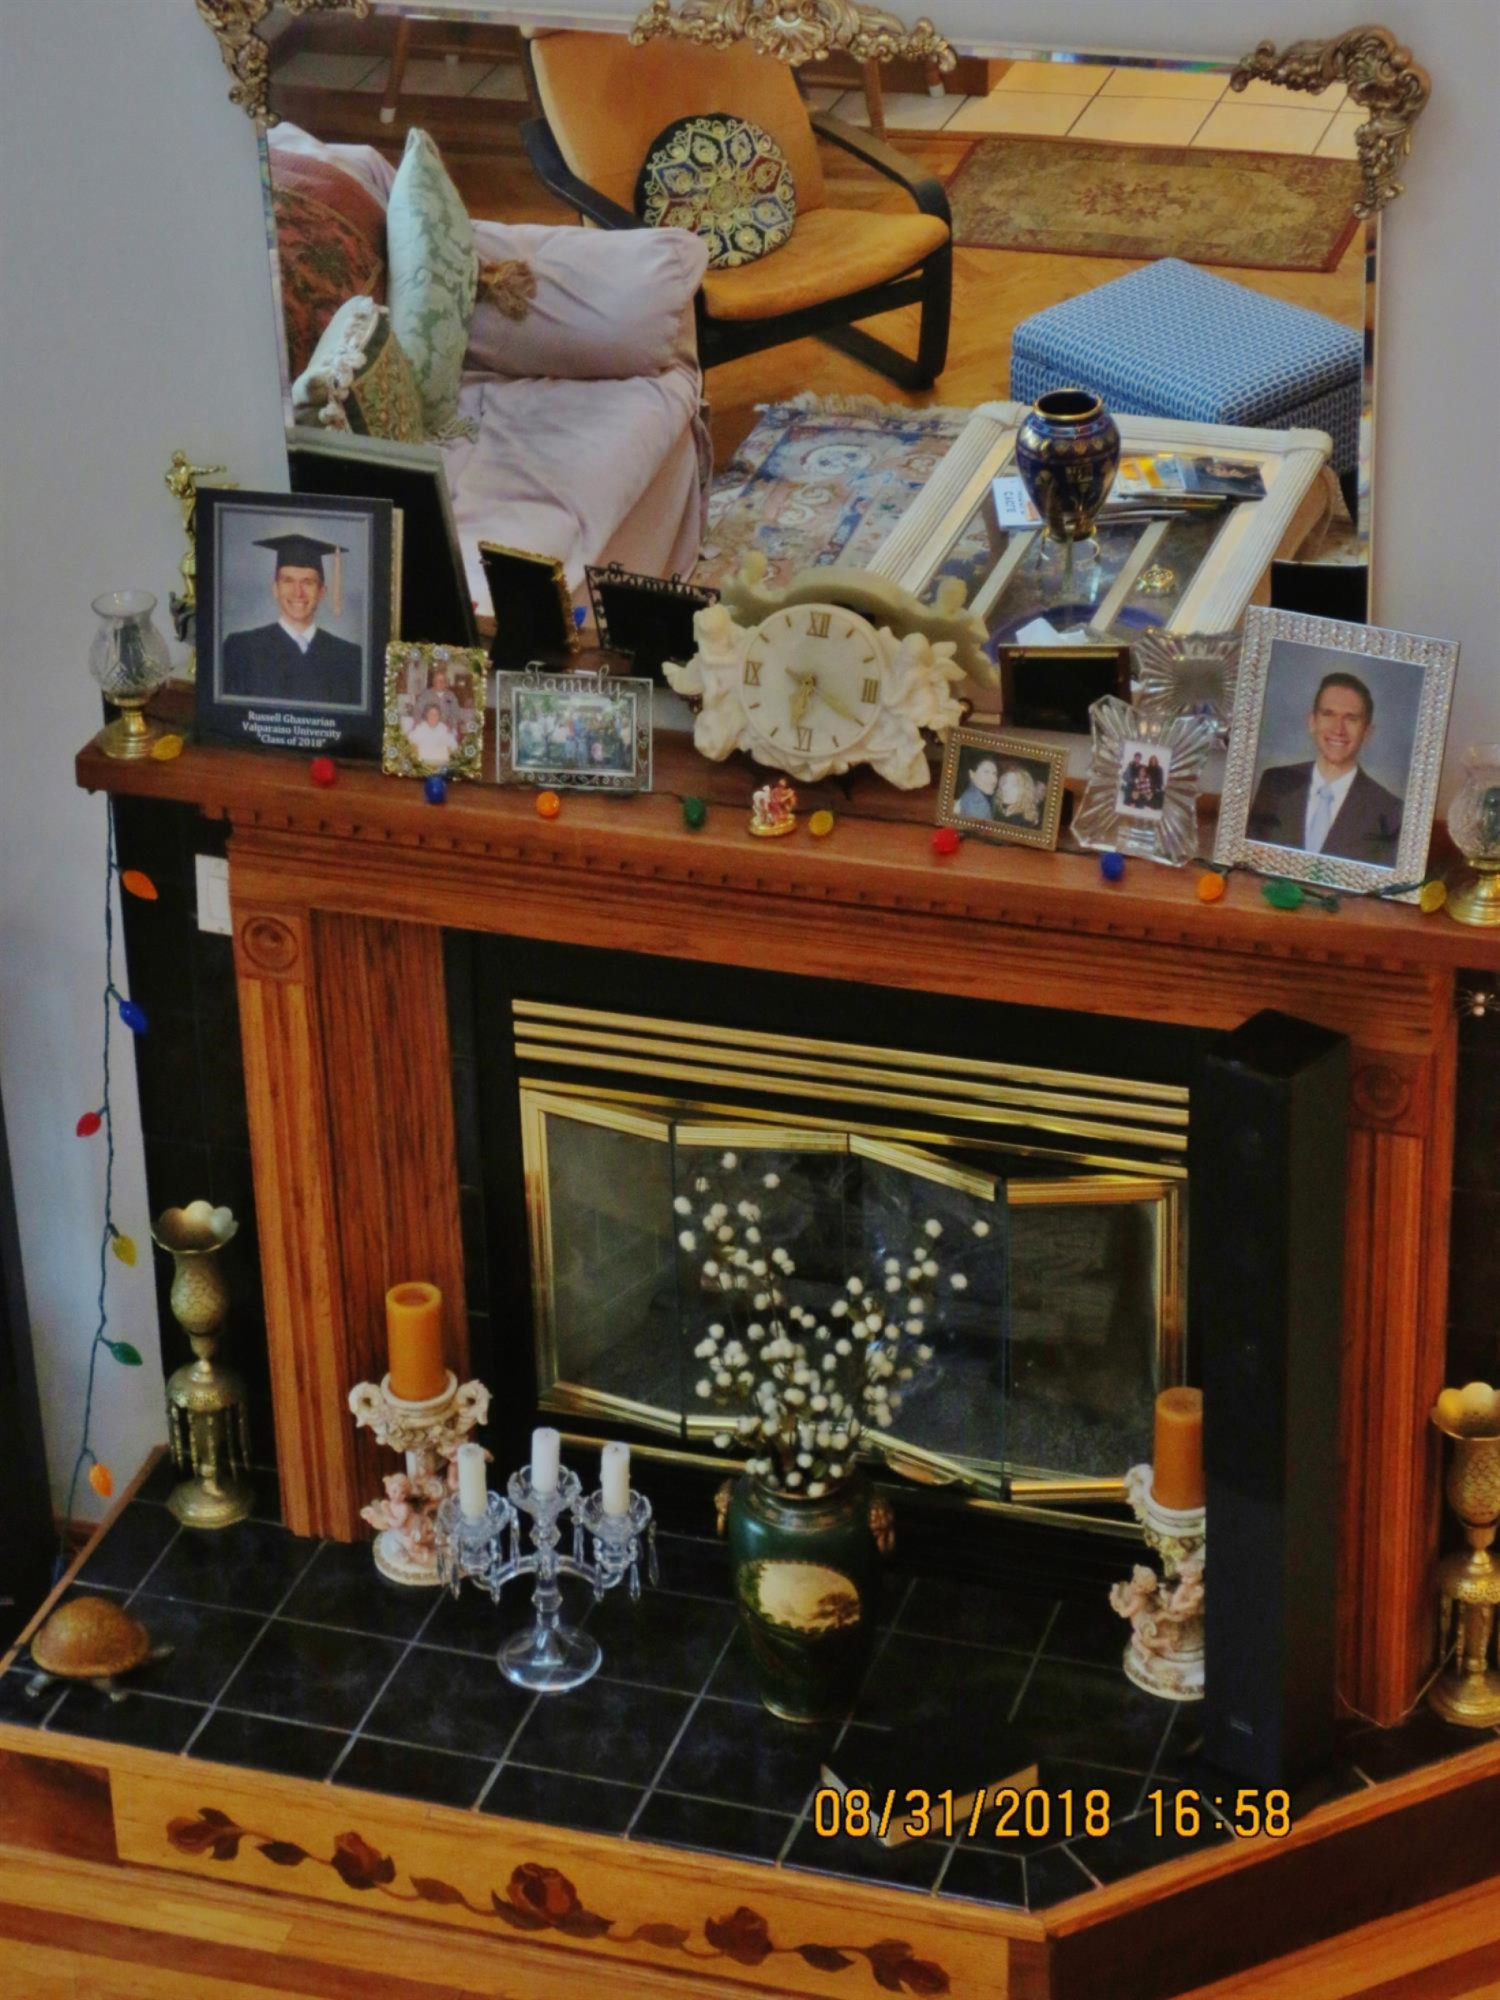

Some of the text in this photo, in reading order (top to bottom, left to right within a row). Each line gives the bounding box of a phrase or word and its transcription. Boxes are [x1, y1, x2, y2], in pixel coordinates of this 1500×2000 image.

[807, 612, 831, 639] XII
[522, 661, 625, 699] Family
[744, 661, 761, 687] IX
[861, 678, 878, 704] III
[248, 710, 281, 722] Russell
[287, 736, 297, 745] of
[293, 726, 341, 741] University
[796, 727, 814, 752] VI
